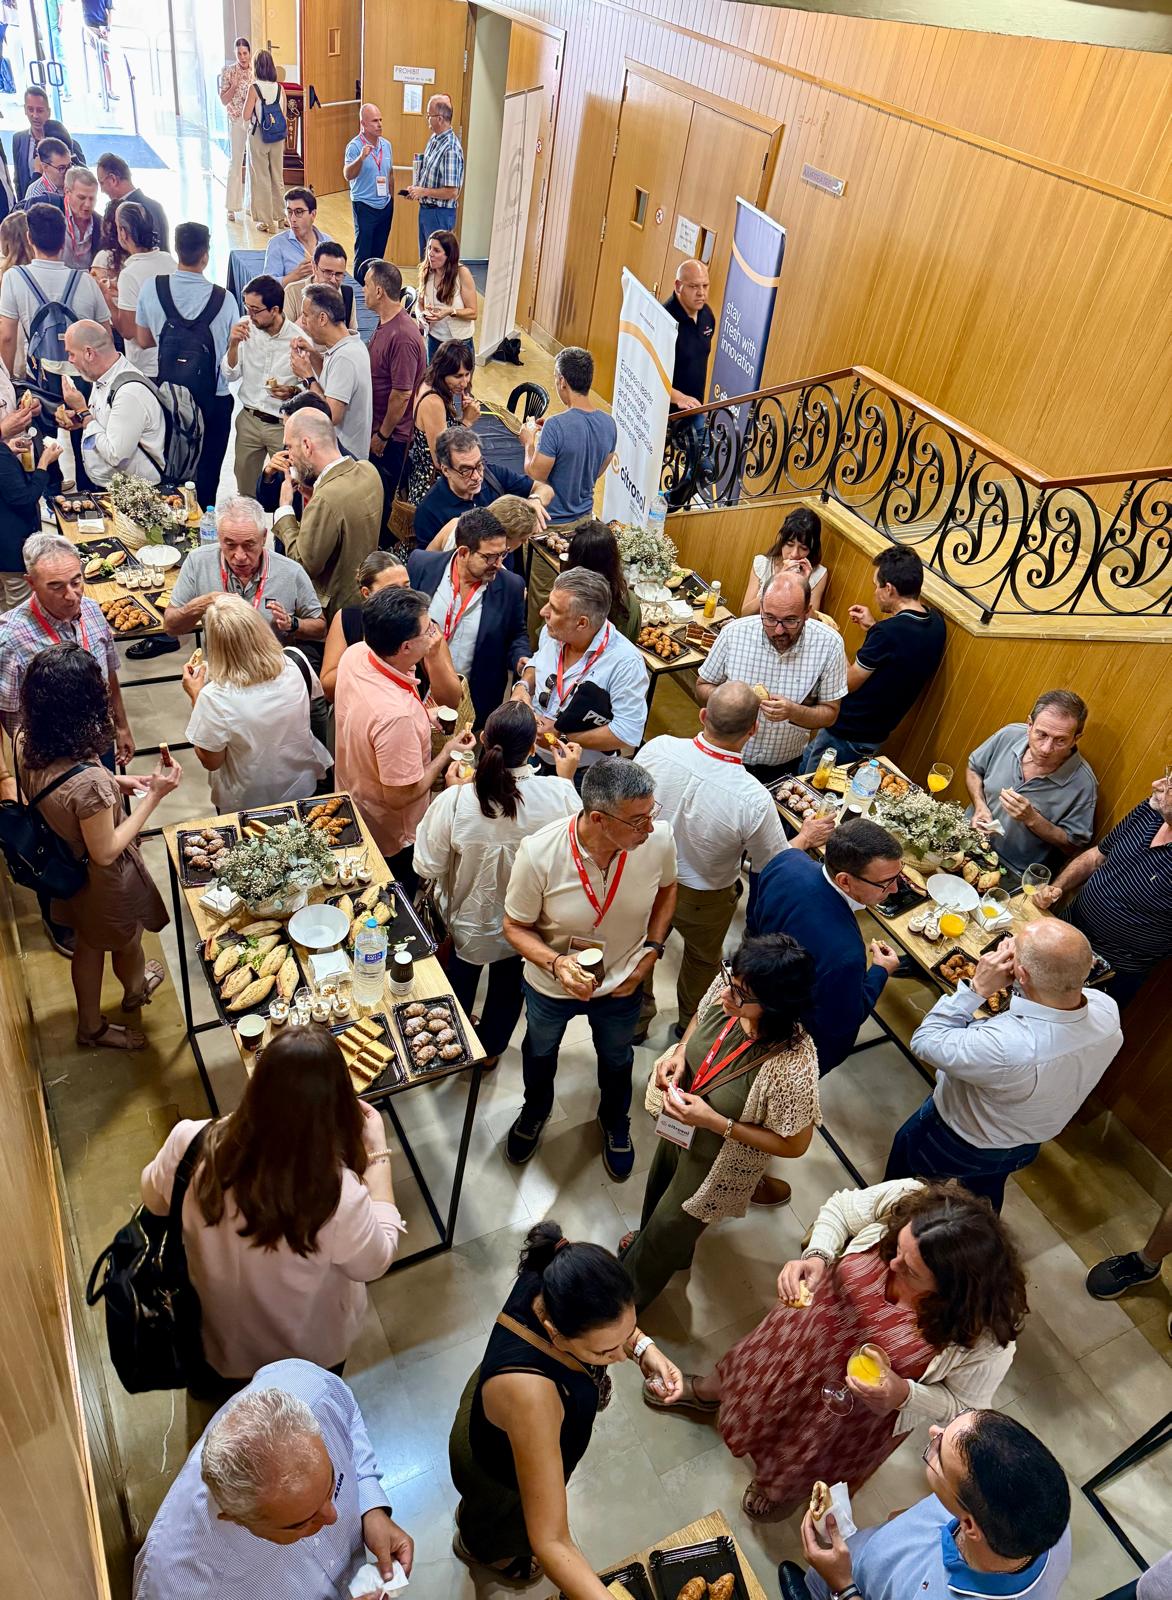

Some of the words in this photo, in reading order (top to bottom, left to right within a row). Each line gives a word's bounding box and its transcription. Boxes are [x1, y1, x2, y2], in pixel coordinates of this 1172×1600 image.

[726, 302, 741, 325] stay
[721, 334, 755, 379] innovation
[724, 317, 741, 345] fresh
[742, 335, 757, 359] with
[620, 466, 646, 513] citrosol
